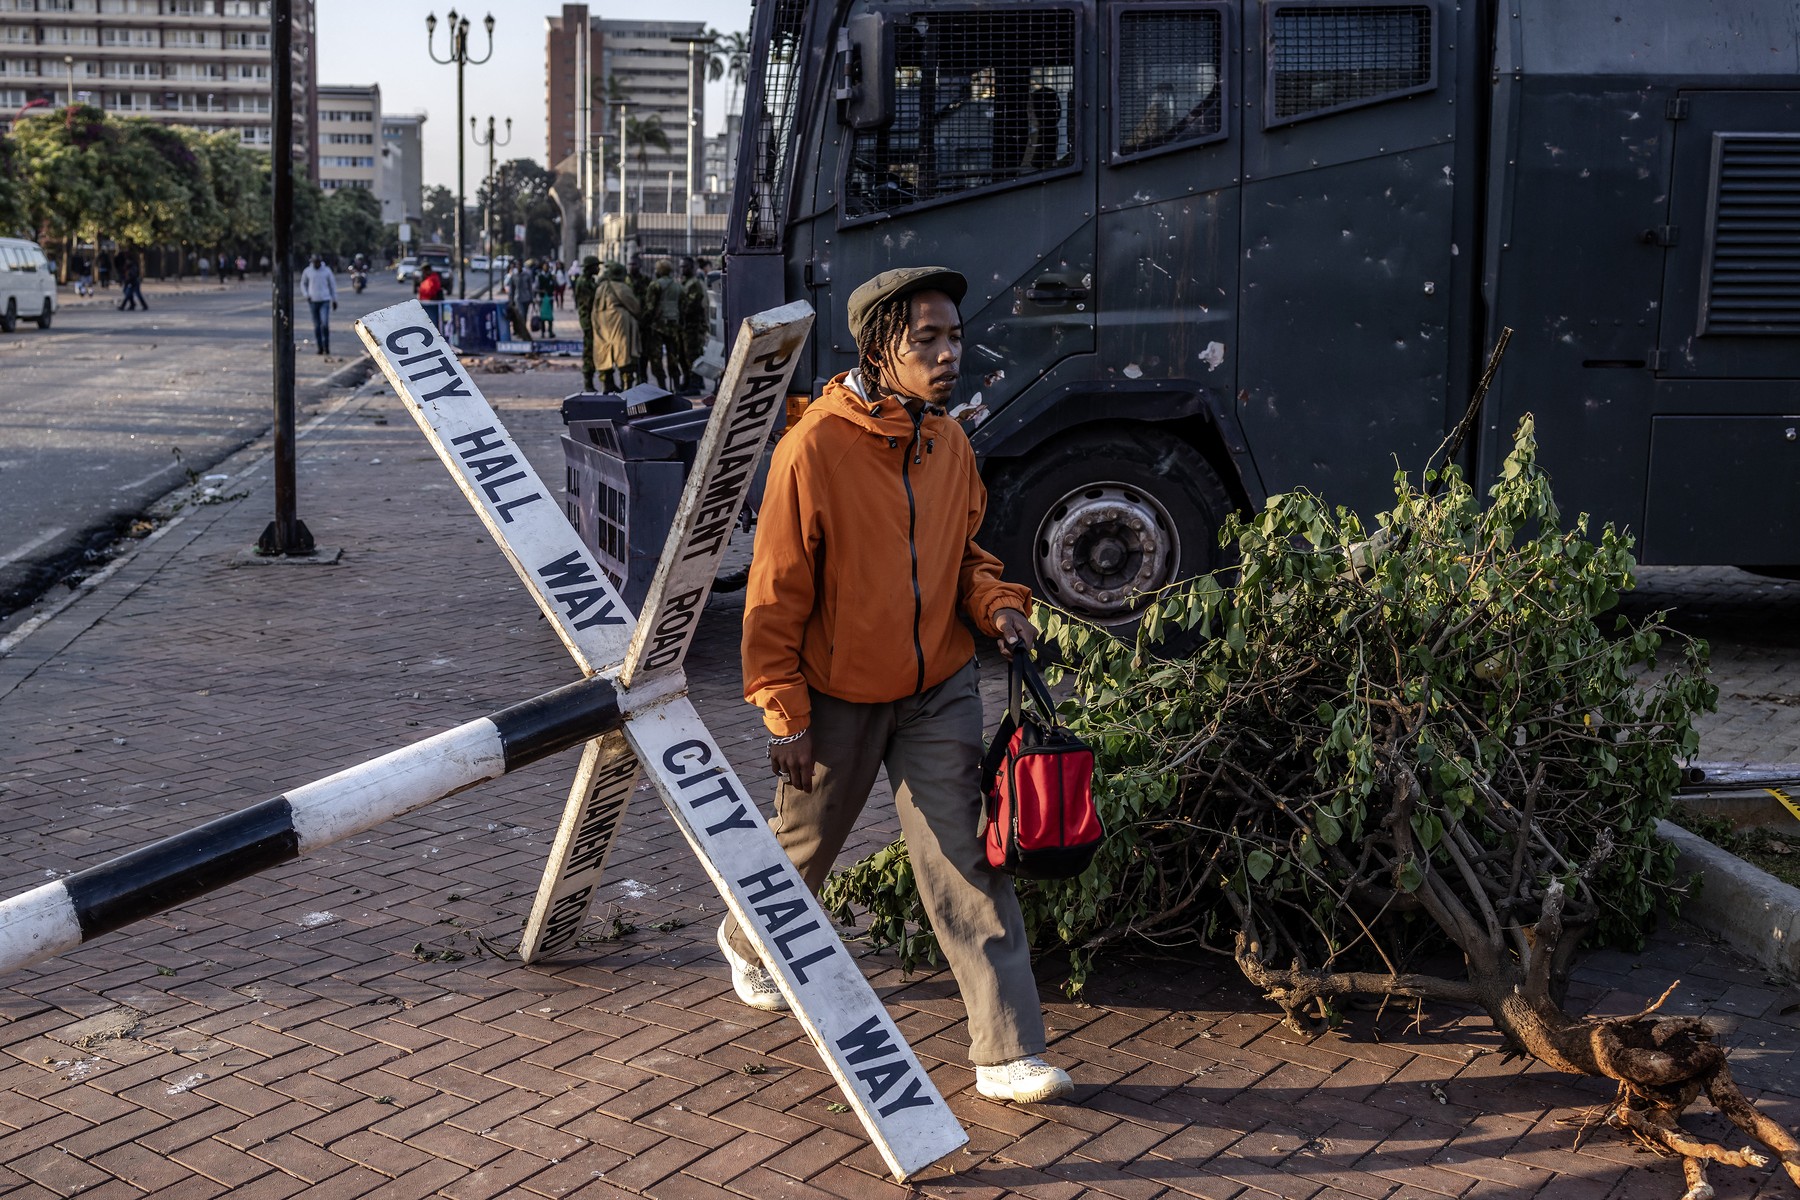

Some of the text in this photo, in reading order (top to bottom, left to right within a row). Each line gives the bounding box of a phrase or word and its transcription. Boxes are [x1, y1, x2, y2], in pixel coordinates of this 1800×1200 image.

[386, 326, 626, 632] CITY HALL WAY
[643, 350, 792, 671] PARLIAMENT ROAD
[539, 885, 592, 952] ROAD
[662, 739, 934, 1118] CITY HALL WAY
